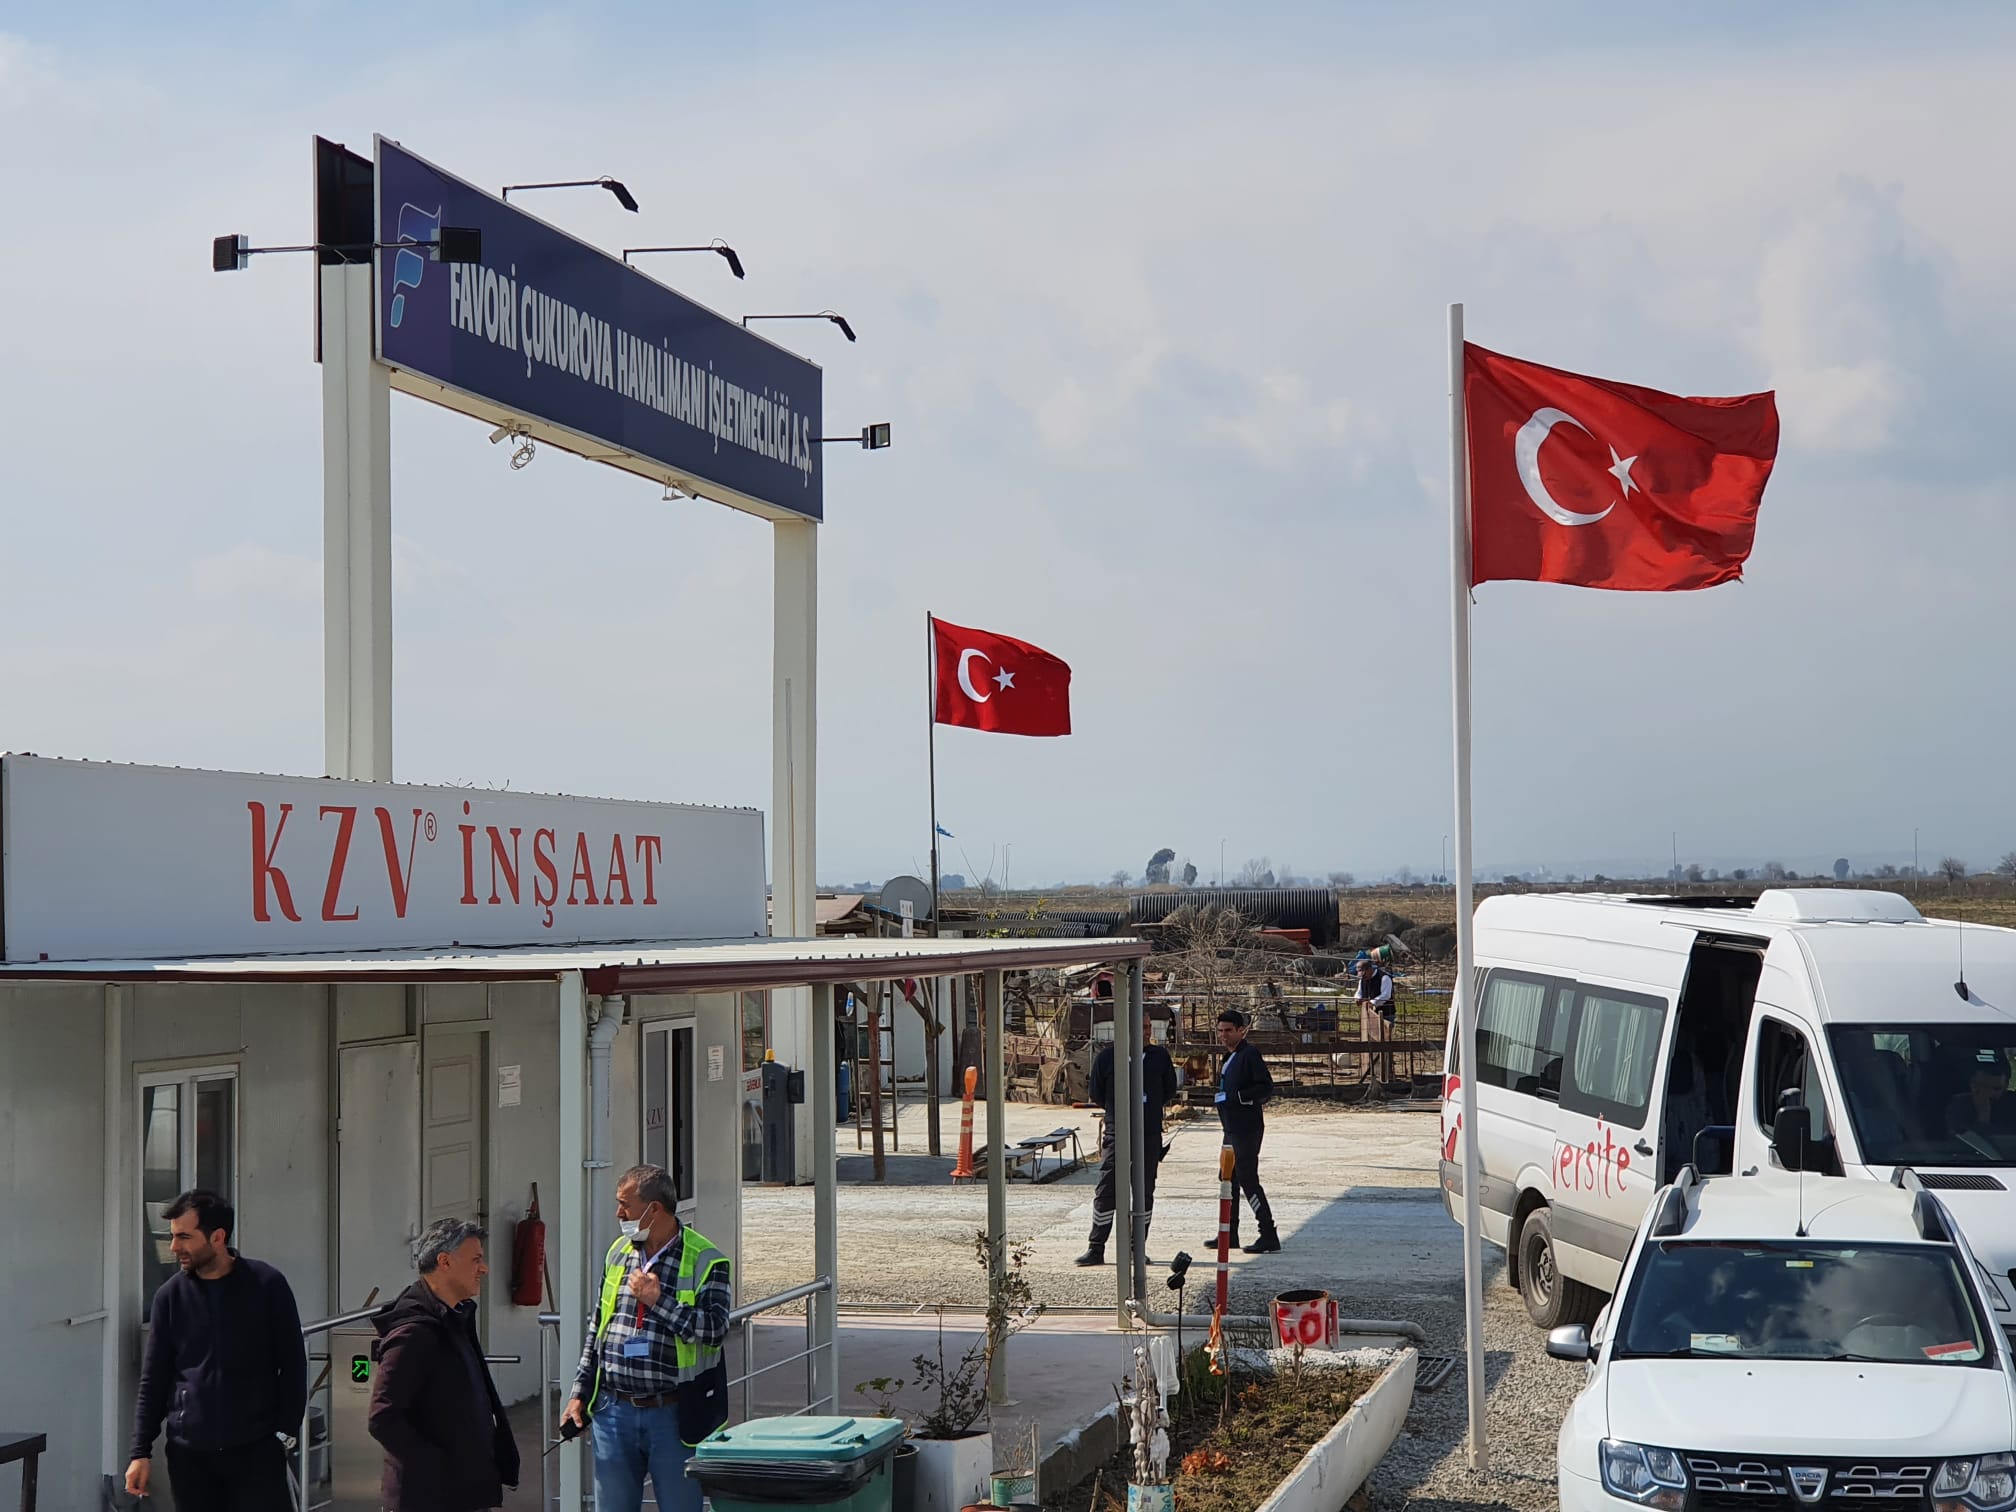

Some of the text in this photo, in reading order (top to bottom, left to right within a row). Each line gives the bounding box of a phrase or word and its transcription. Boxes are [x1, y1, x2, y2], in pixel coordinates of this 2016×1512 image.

[450, 262, 517, 351] FAVORİ
[521, 285, 614, 390] ÇUKUROVA
[616, 328, 706, 431] HAVALİMANI
[708, 359, 790, 465] İŞLETMECİLİĞİ
[458, 800, 662, 929] İNŞAAT
